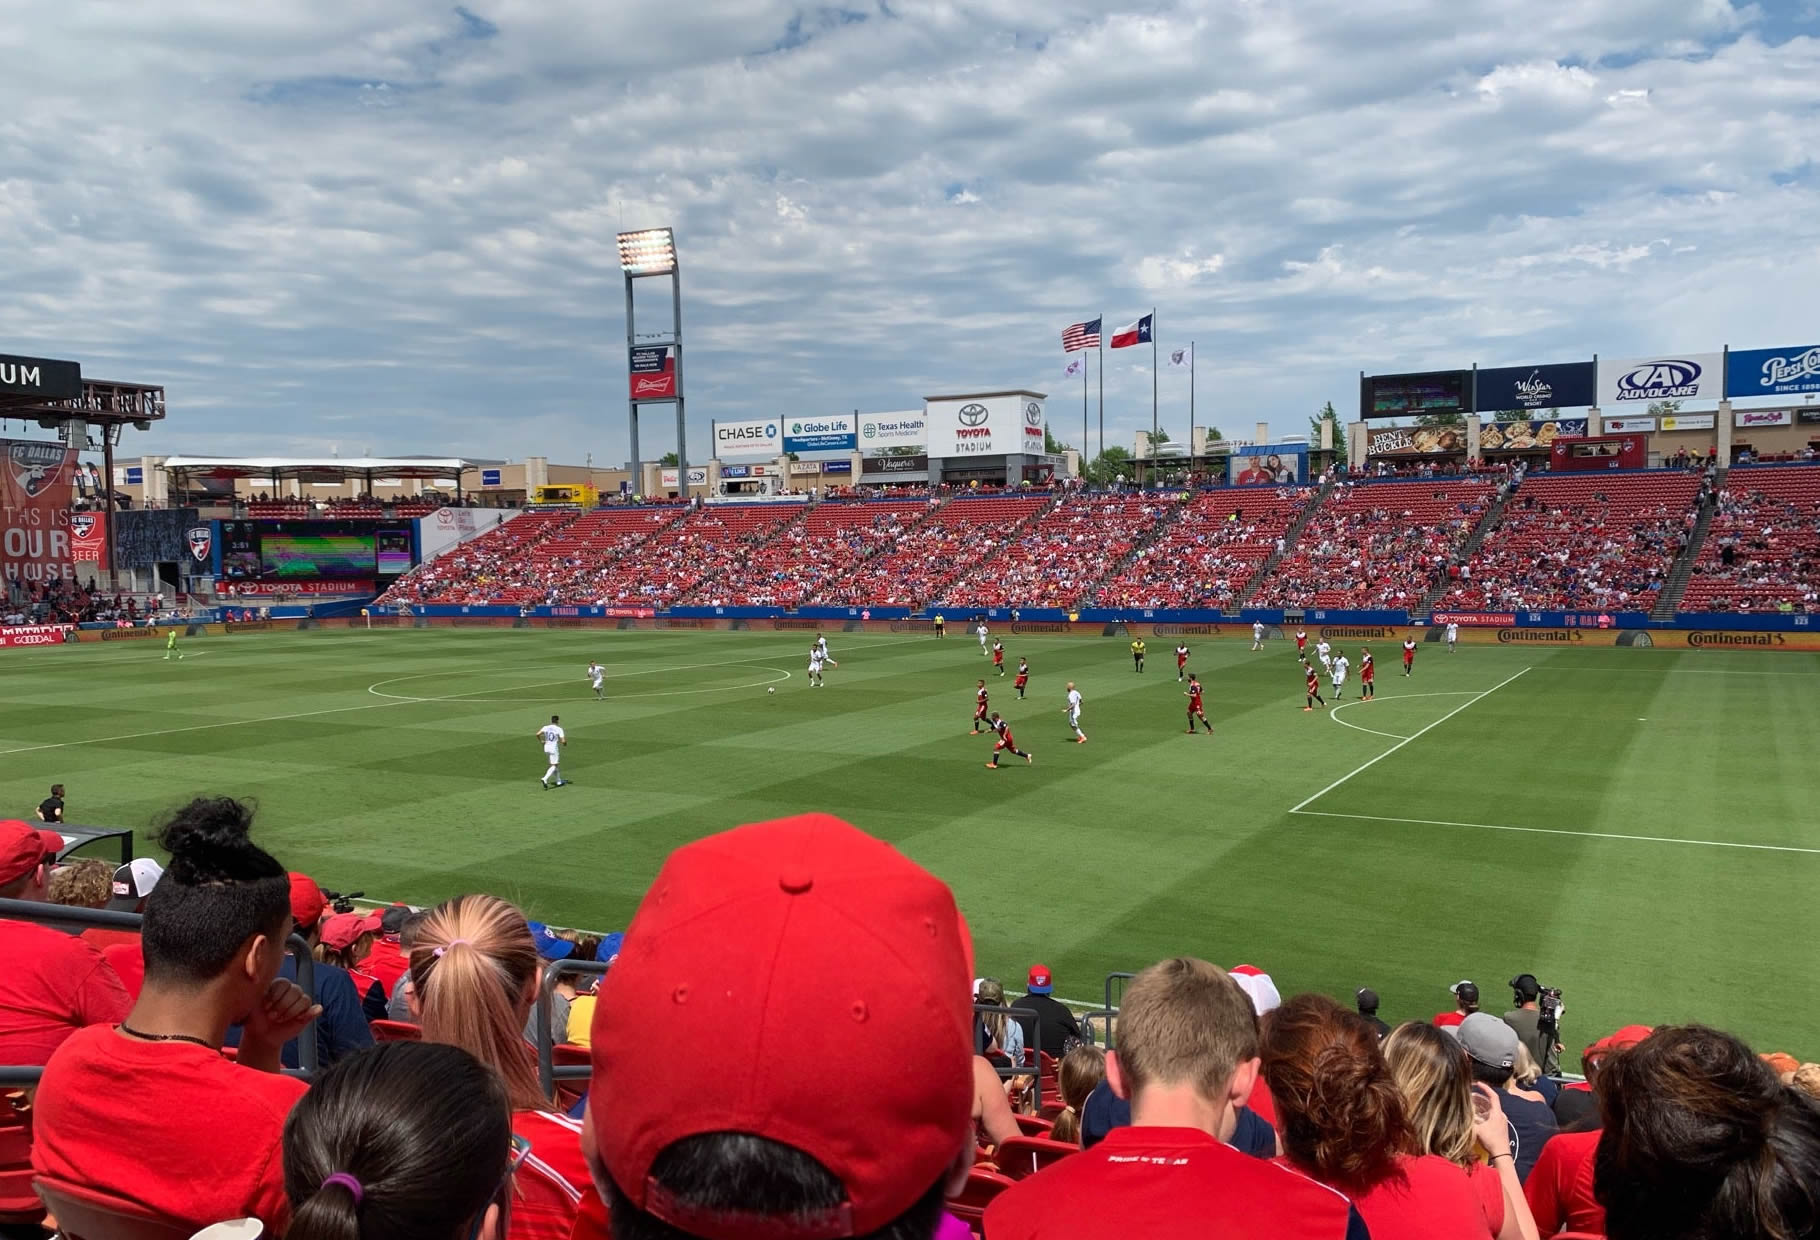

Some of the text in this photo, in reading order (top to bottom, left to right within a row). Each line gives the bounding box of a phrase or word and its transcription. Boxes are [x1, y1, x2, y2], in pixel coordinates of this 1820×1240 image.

[1514, 379, 1552, 395] WinStar
[1616, 384, 1699, 400] ADVOCARE
[1775, 384, 1799, 392] SINCE
[804, 421, 848, 433] Globe Life
[878, 420, 924, 431] Texas Health
[719, 426, 763, 440] CHASE
[878, 431, 894, 439] Sports
[956, 427, 991, 439] TOYOTA
[1373, 429, 1405, 445] BENT
[956, 441, 992, 453] STADIUM
[1367, 437, 1413, 456] BUCKLE
[13, 446, 63, 461] FC DALLAS
[51, 508, 69, 527] IS
[4, 527, 71, 558] OUR
[260, 582, 356, 593] TOYOTA STADIUM
[1450, 615, 1514, 624] TOYOTA STADIUM
[1011, 621, 1064, 634] Continental
[1153, 624, 1212, 637] Continental
[1320, 626, 1385, 639] Continental
[1497, 628, 1571, 643] Continental
[1687, 631, 1772, 647] Continental
